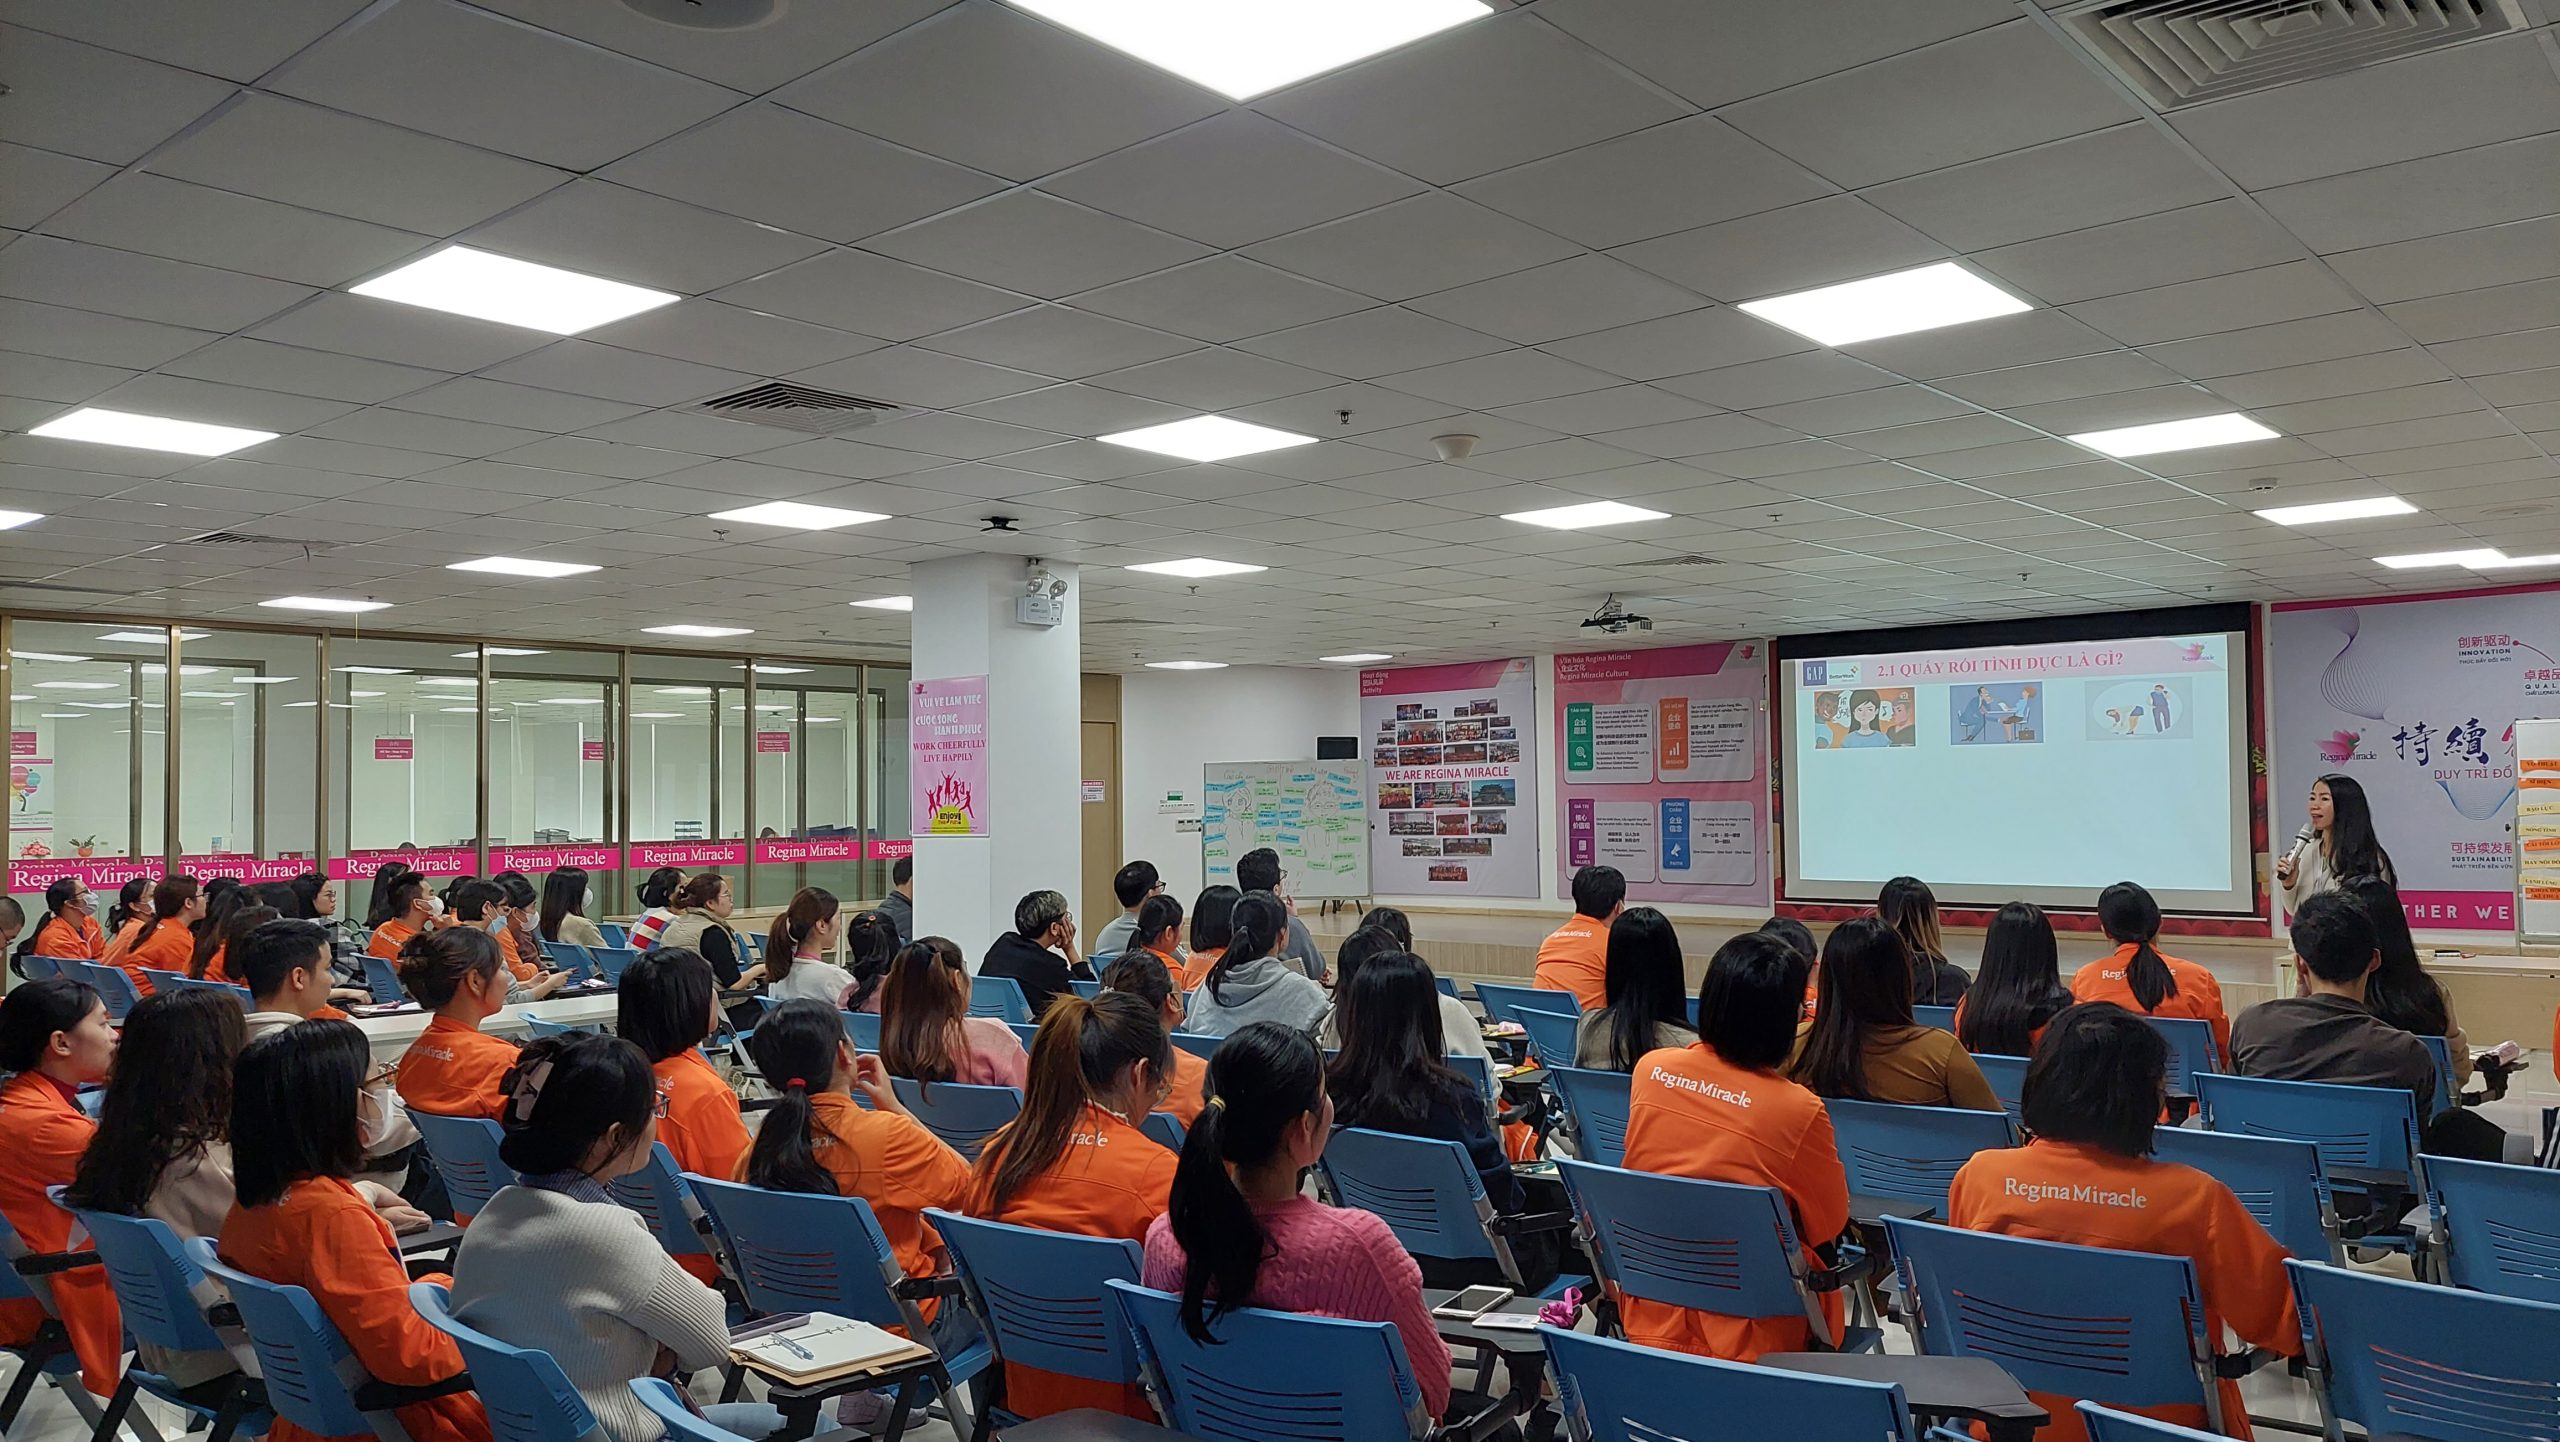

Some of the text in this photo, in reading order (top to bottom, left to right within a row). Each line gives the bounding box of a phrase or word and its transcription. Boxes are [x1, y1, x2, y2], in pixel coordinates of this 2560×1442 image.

[2458, 633, 2511, 648] 创新驱动
[2458, 648, 2511, 656] INNOVATION
[1806, 666, 1823, 681] GAP
[1877, 664, 1895, 677] 2.1
[913, 739, 986, 751] WORK CHEERFULLY
[923, 752, 973, 763] LIVE HAPPILY
[1385, 766, 1510, 781] WE ARE REGINA MIRACLE
[2434, 768, 2461, 780] DUY
[2465, 766, 2488, 779] TRÌ
[644, 847, 735, 865] Regina Miracle
[768, 843, 849, 860] Regina Miracle
[878, 842, 912, 856] Regina
[406, 855, 462, 872] Miracle
[504, 851, 606, 871] Regina Miracle
[90, 866, 162, 885] Miracle
[184, 861, 313, 881] Regina Miracle
[2401, 904, 2510, 920] THER WE
